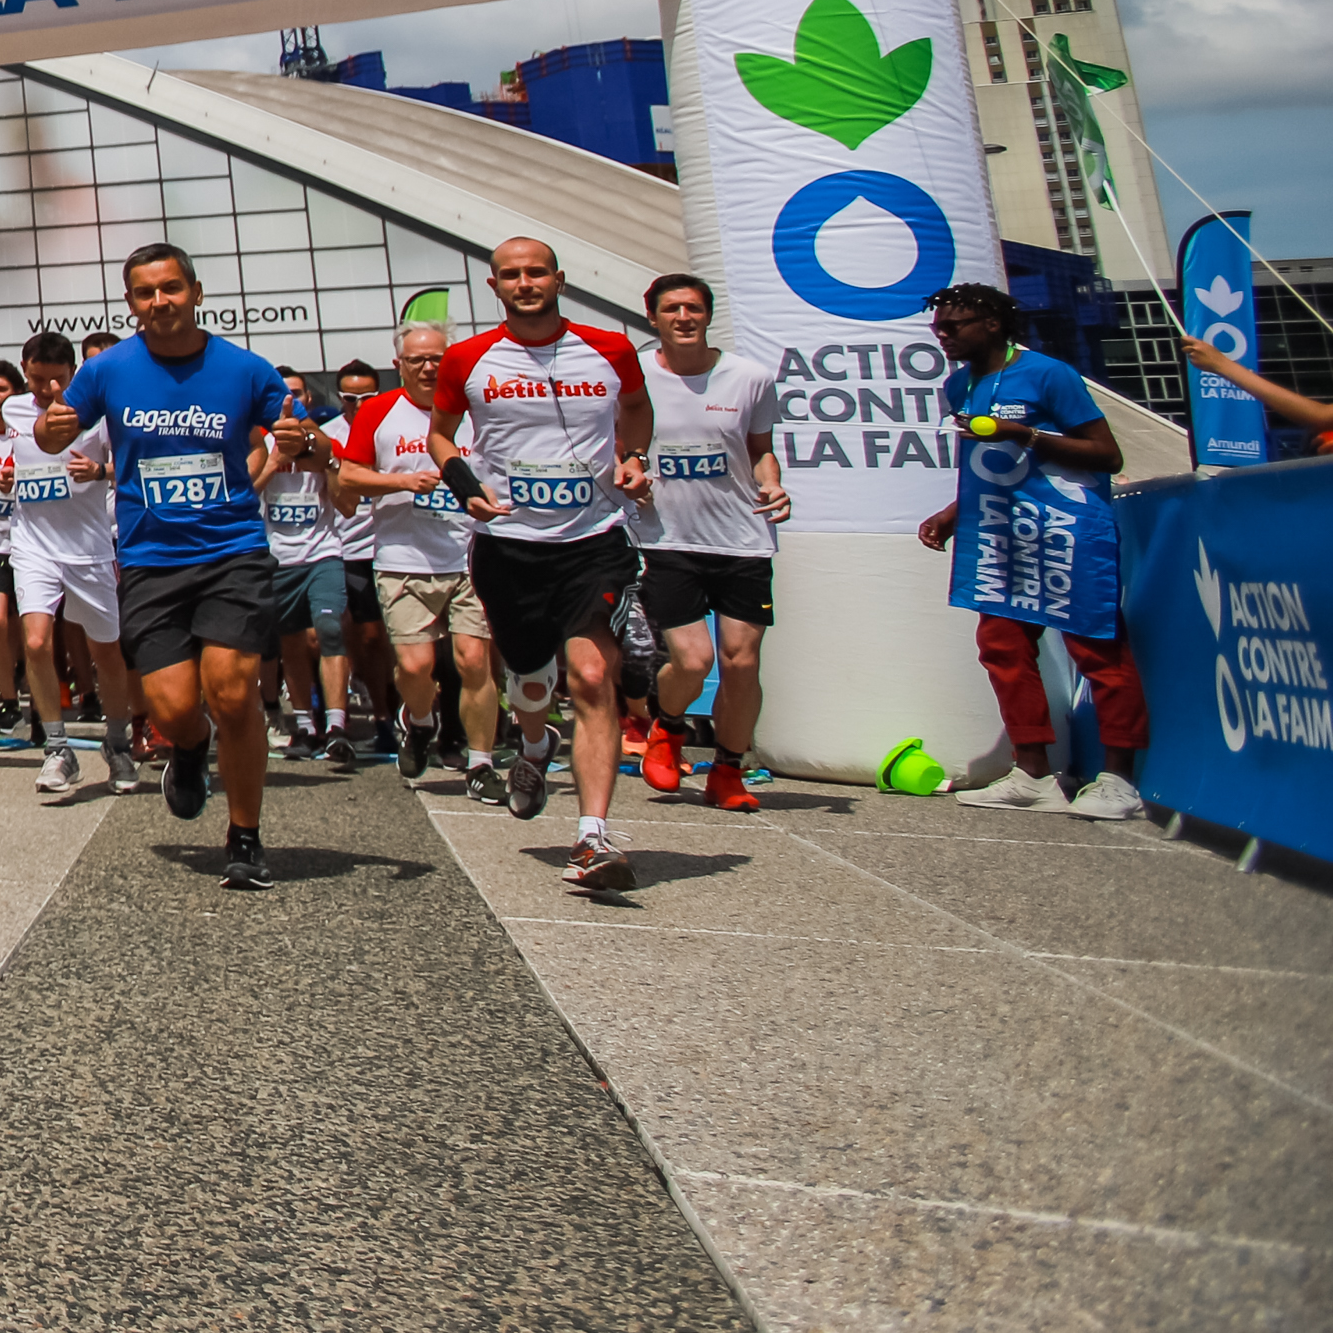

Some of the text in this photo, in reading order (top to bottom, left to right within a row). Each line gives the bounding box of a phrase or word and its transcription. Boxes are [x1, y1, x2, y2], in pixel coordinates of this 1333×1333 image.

[482, 380, 608, 404] petit futé
[778, 387, 951, 423] CONT
[1200, 387, 1219, 399] LA
[122, 404, 227, 433] Lagardère
[158, 426, 224, 440] TRAVEL RETAIL
[783, 430, 959, 468] LA FAI
[1207, 436, 1260, 452] Amundi
[660, 456, 726, 476] 3144
[18, 477, 68, 501] 4075
[148, 475, 223, 504] 1287
[511, 480, 592, 505] 3060
[270, 506, 317, 523] 3254
[973, 493, 1009, 603] LA FAIM
[1010, 500, 1040, 612] CONTRE
[1042, 504, 1077, 620] ACTION
[1228, 581, 1311, 632] ACTION
[1237, 635, 1328, 690] CONTRE
[1245, 688, 1333, 752] LA FAIM
